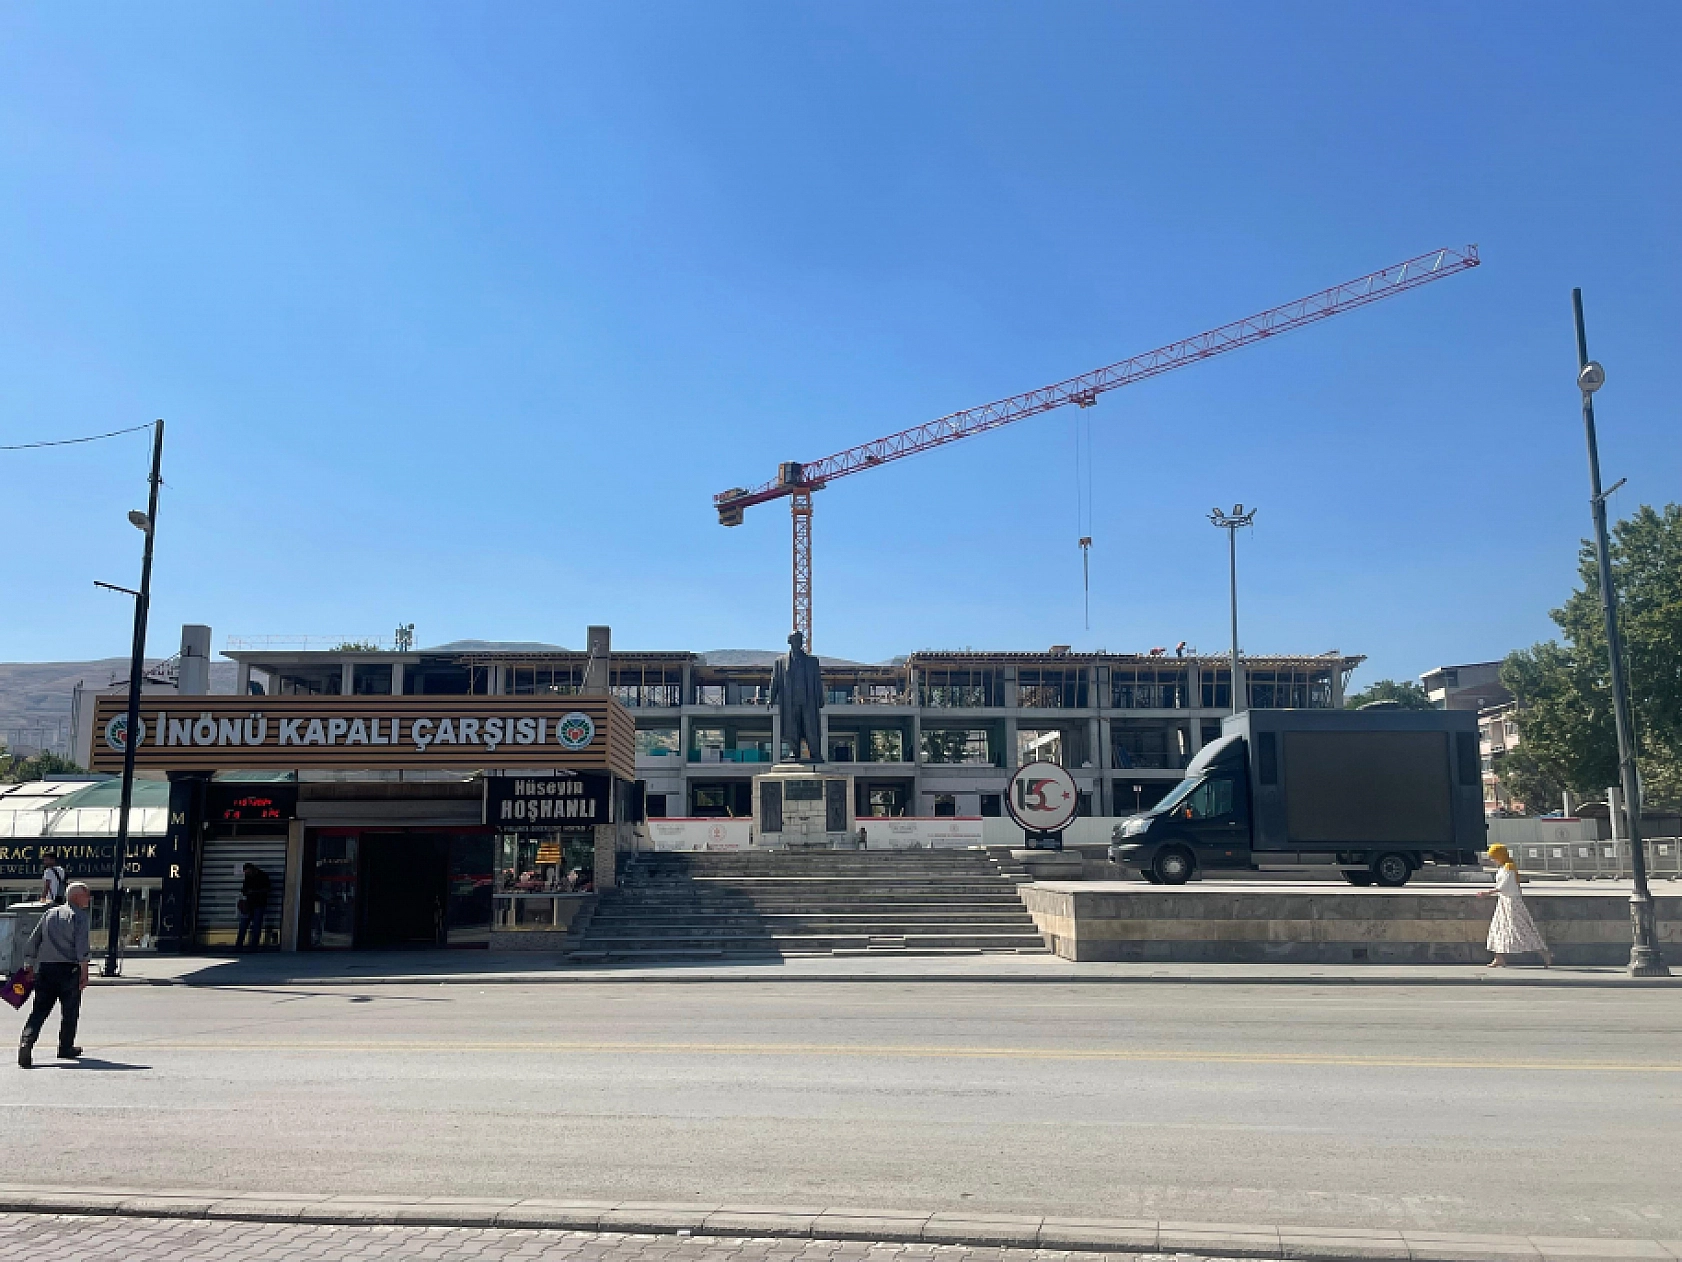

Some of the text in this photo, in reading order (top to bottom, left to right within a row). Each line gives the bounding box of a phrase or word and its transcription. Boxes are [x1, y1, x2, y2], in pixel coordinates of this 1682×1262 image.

[155, 712, 547, 752] İNÖNÜ KAPALI ÇARŞISI
[514, 778, 584, 796] Hüseyin
[500, 798, 597, 823] HOŞHANLI
